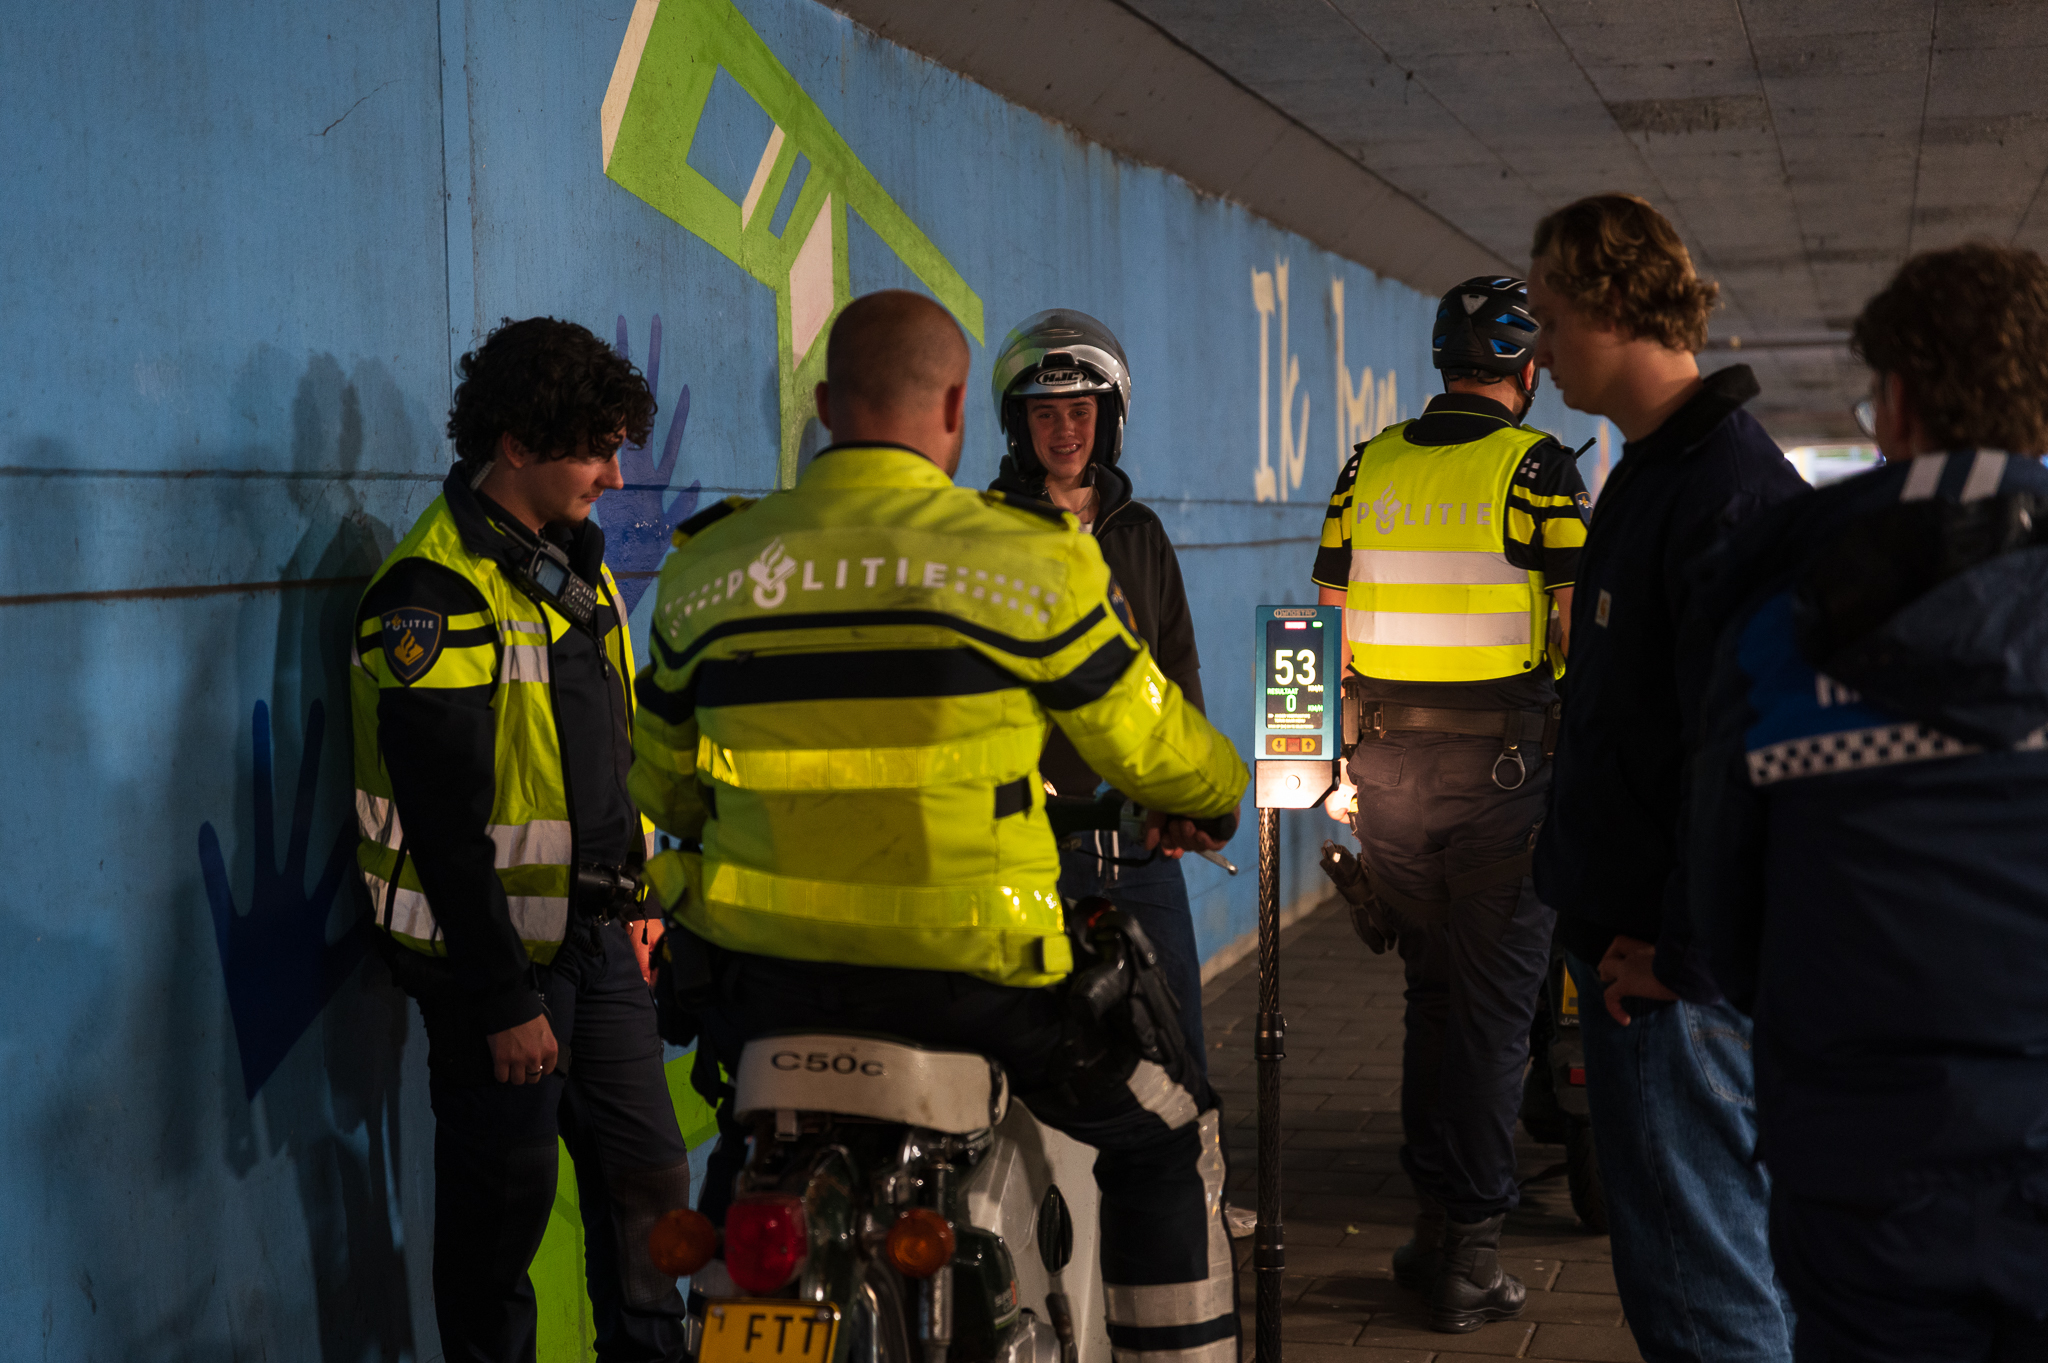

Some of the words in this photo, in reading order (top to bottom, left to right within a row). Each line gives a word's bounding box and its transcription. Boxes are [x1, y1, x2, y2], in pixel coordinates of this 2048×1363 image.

[1042, 371, 1081, 382] HJC
[1357, 488, 1492, 535] POLITIE
[726, 541, 948, 609] POLITIE
[385, 614, 434, 631] POLITIE
[1274, 649, 1316, 686] 53
[1267, 687, 1299, 695] RESULTAAT
[1286, 694, 1297, 713] 0
[771, 1051, 885, 1077] C50c
[745, 1314, 825, 1352] FTT
